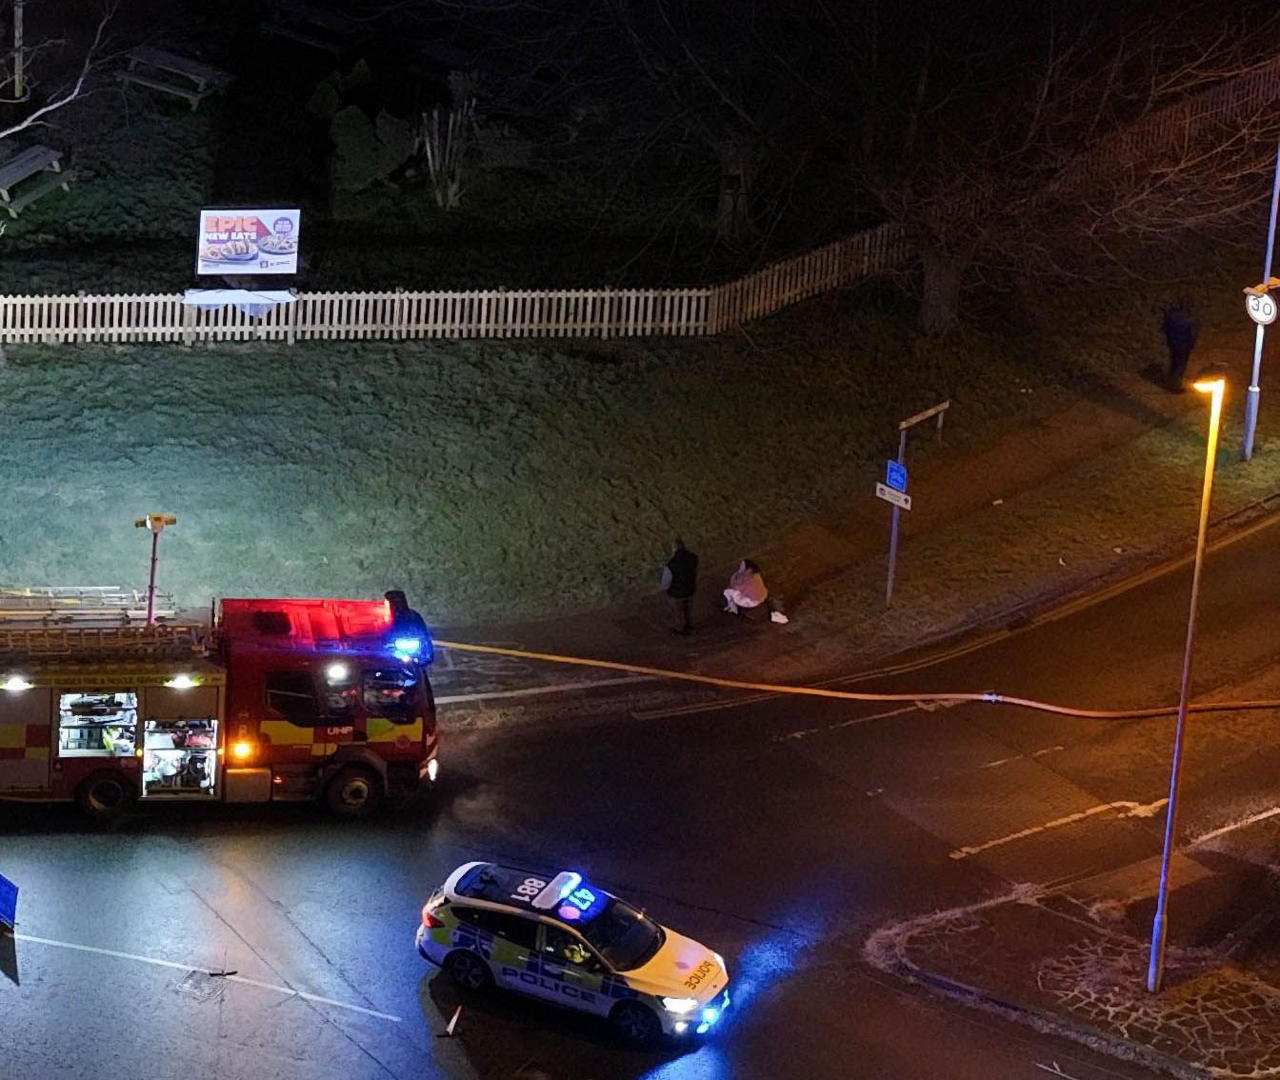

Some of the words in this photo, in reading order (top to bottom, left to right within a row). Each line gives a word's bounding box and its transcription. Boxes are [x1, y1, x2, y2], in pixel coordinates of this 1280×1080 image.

[205, 216, 258, 233] EPIC
[206, 231, 229, 241] NEW
[231, 231, 257, 241] EATS
[1251, 297, 1272, 316] 30
[509, 877, 547, 902] 881
[568, 888, 596, 911] 47
[501, 966, 597, 1005] POLICE
